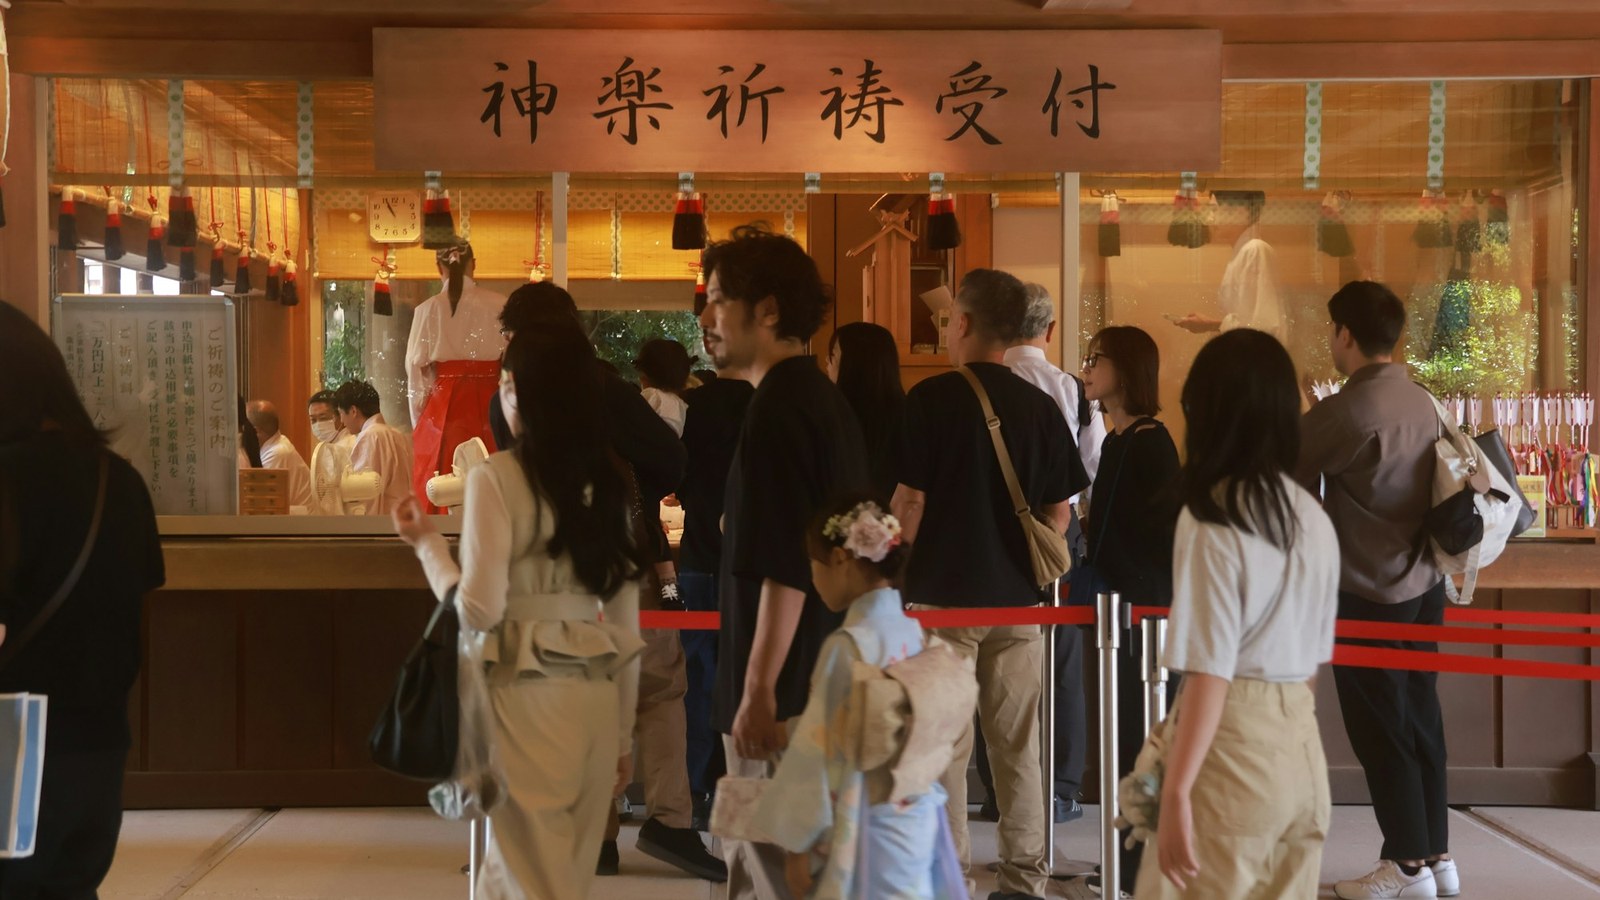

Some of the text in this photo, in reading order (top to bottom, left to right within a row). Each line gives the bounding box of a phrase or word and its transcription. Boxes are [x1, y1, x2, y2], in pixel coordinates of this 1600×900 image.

[479, 57, 1118, 147] 神楽祈祷受付
